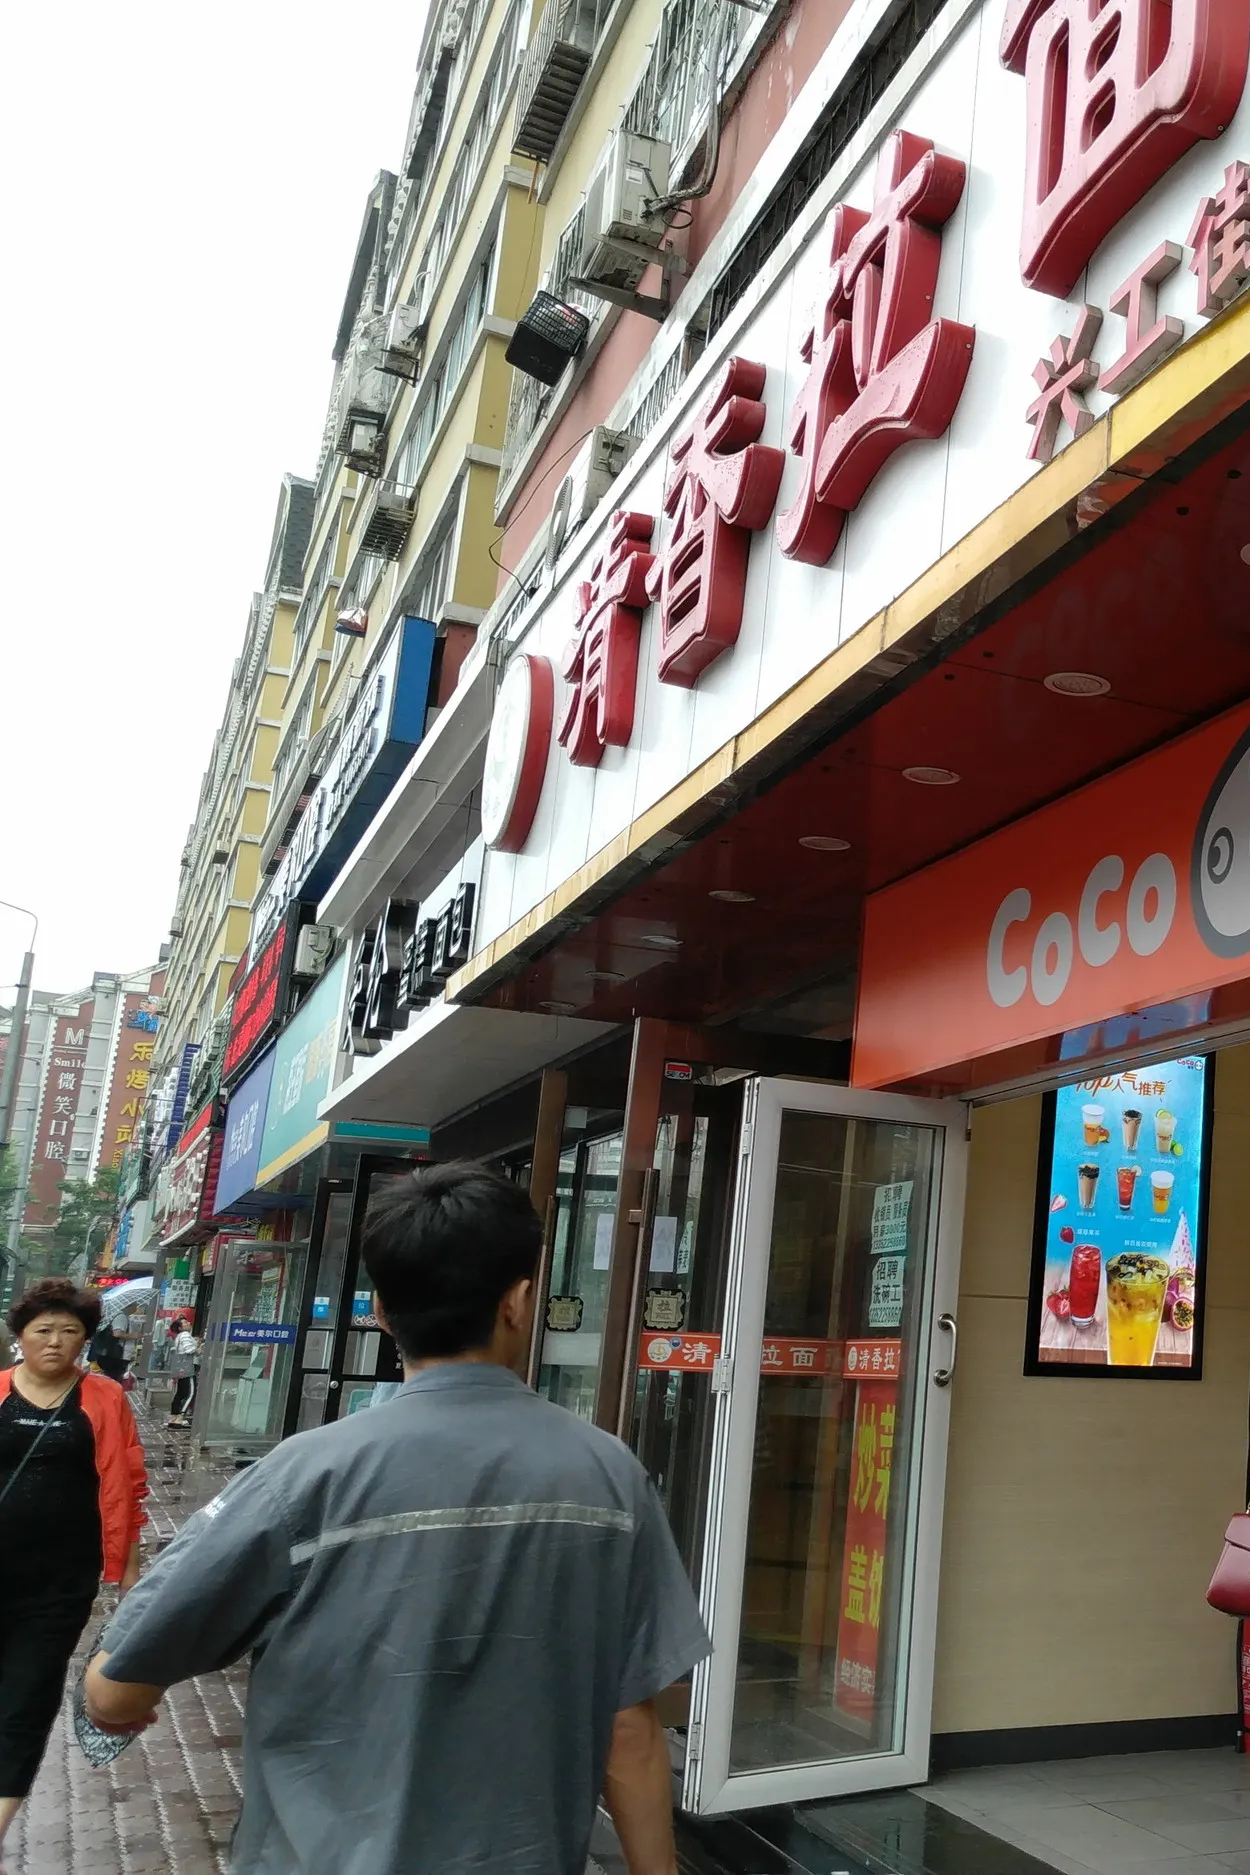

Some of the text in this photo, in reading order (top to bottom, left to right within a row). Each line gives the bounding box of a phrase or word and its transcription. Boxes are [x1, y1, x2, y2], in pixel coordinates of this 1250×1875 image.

[556, 0, 1250, 768] 清香拉面
[986, 852, 1177, 1008] CoCo
[1112, 1072, 1166, 1096] 人气推荐
[44, 1071, 78, 1160] 微笑口腔
[883, 1184, 903, 1203] 招聘
[876, 1260, 899, 1281] 招聘
[873, 1283, 901, 1304] 洗碗工
[257, 1329, 290, 1339] 美尔口腔
[859, 1347, 901, 1372] 清香拉
[840, 1657, 876, 1697] 经济实
